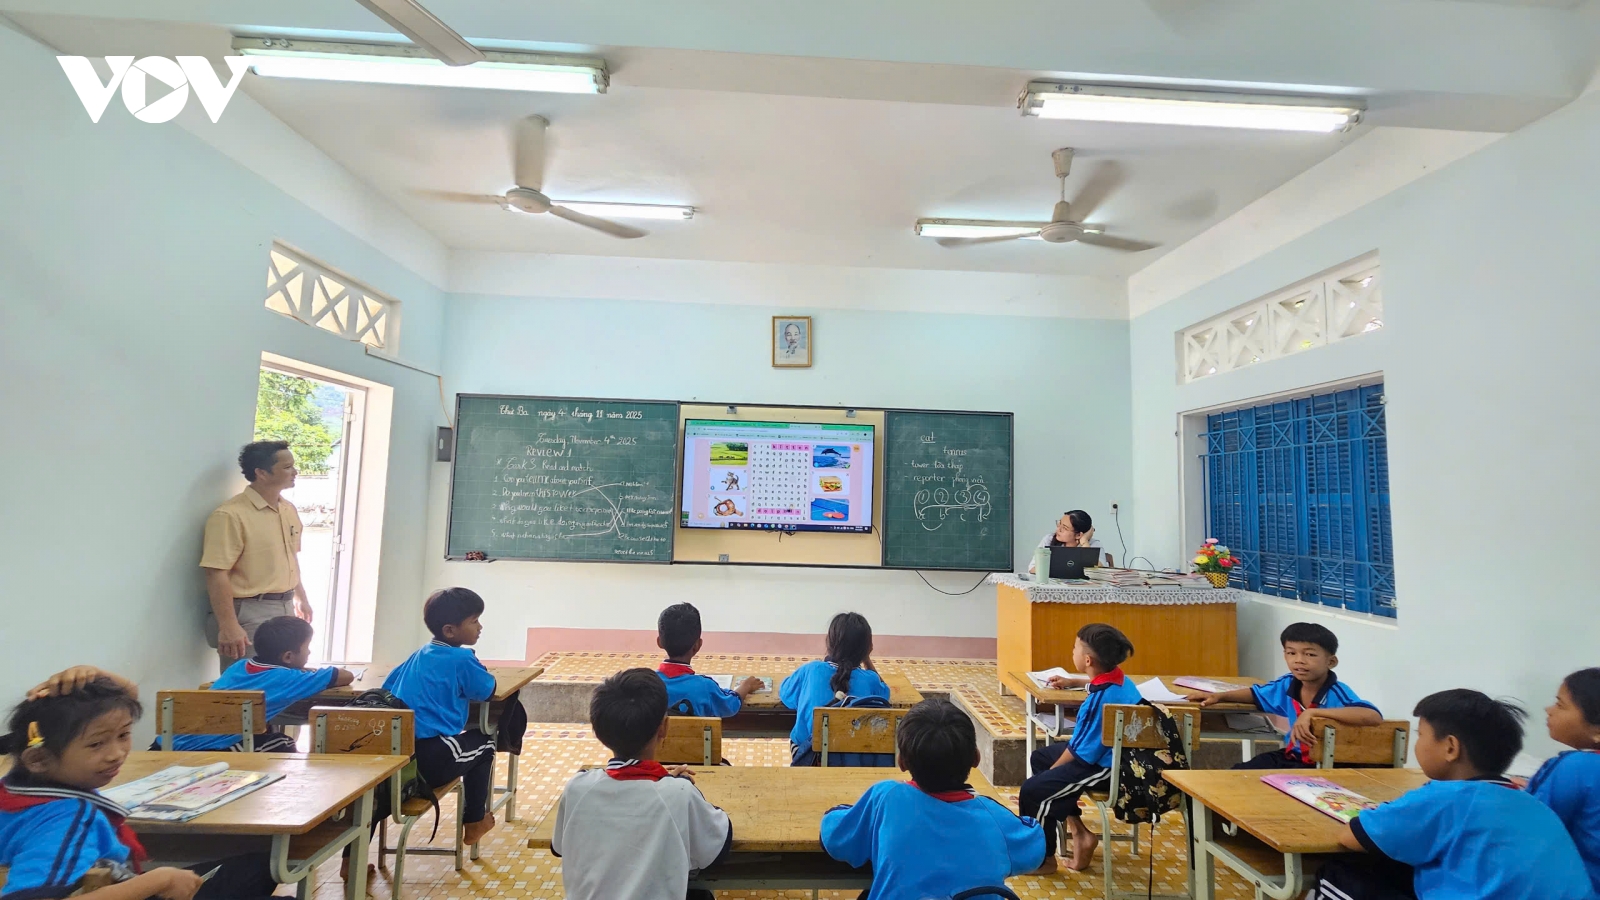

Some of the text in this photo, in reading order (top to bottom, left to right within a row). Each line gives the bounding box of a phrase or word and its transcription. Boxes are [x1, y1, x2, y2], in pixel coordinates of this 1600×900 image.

[517, 405, 529, 416] Ba
[537, 409, 557, 421] ngày
[558, 408, 567, 417] 4
[571, 407, 594, 423] tháng
[596, 410, 604, 418] 11
[607, 411, 623, 419] năm
[625, 411, 643, 420] 2025
[617, 436, 637, 446] 2025
[920, 431, 936, 442] cat
[567, 448, 573, 457] 1
[913, 473, 946, 485] reporter
